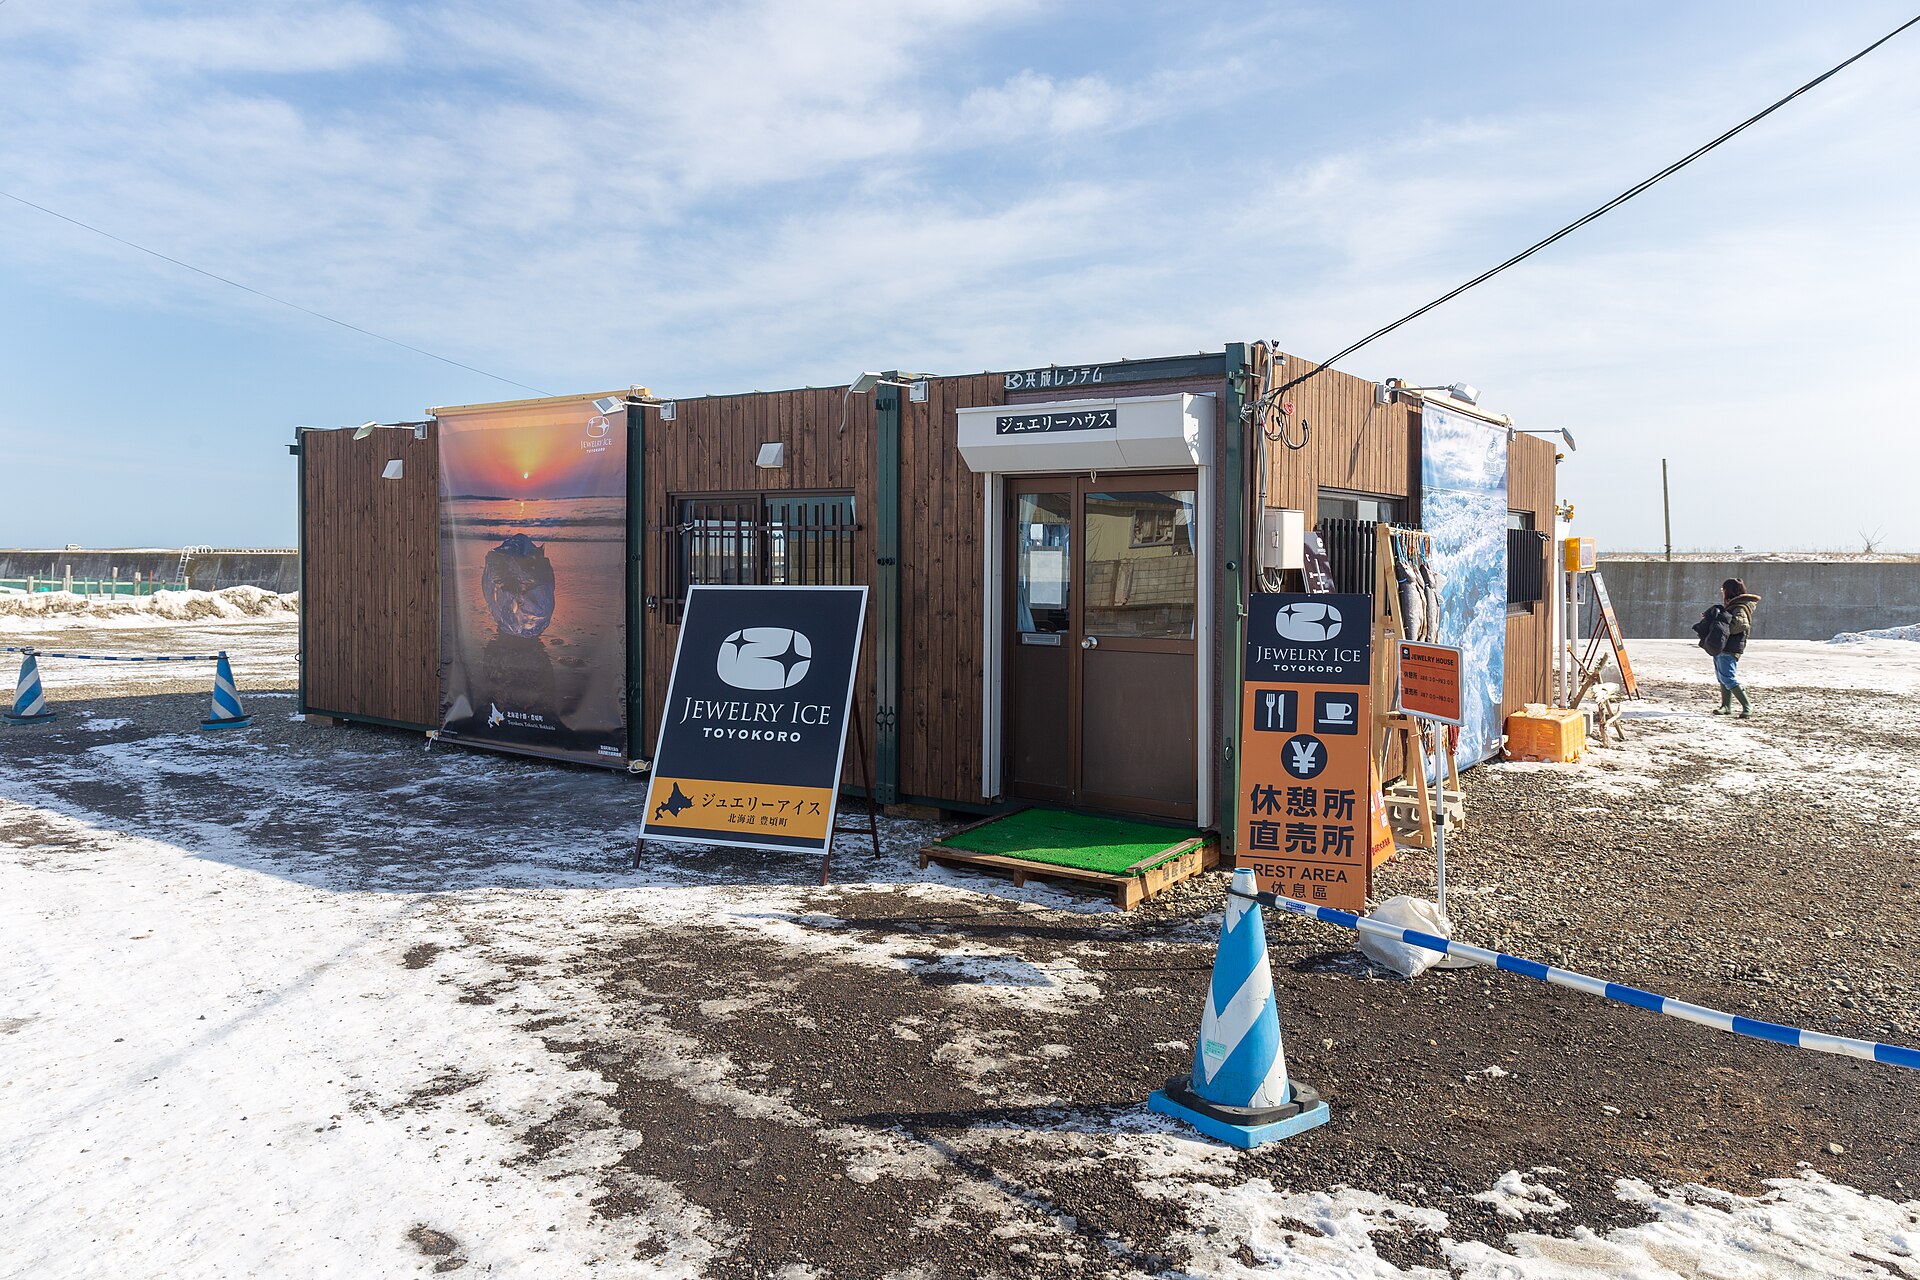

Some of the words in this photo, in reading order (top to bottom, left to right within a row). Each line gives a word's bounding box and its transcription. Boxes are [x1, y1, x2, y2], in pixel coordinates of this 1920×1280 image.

[1026, 367, 1102, 388] 共成レンテム
[1001, 412, 1112, 433] ジュエリーハウス
[1256, 646, 1328, 663] JEWELRY
[1334, 647, 1361, 662] ICE
[1411, 653, 1435, 663] JEWELRY
[1436, 657, 1454, 666] HOUSE
[1273, 664, 1343, 673] TOYOKORO
[680, 697, 785, 725] JEWELRY
[790, 701, 831, 725] ICE
[703, 727, 801, 743] TOYOKORO
[701, 793, 821, 816] ジュエリーアイス
[1250, 783, 1355, 821] 休憩所
[728, 813, 755, 825] 北海道
[759, 814, 788, 827] 豊頃町
[1249, 819, 1355, 858] 直売所
[1254, 863, 1297, 879] REST
[1300, 867, 1348, 883] AREA
[1271, 881, 1328, 900] 休息區
